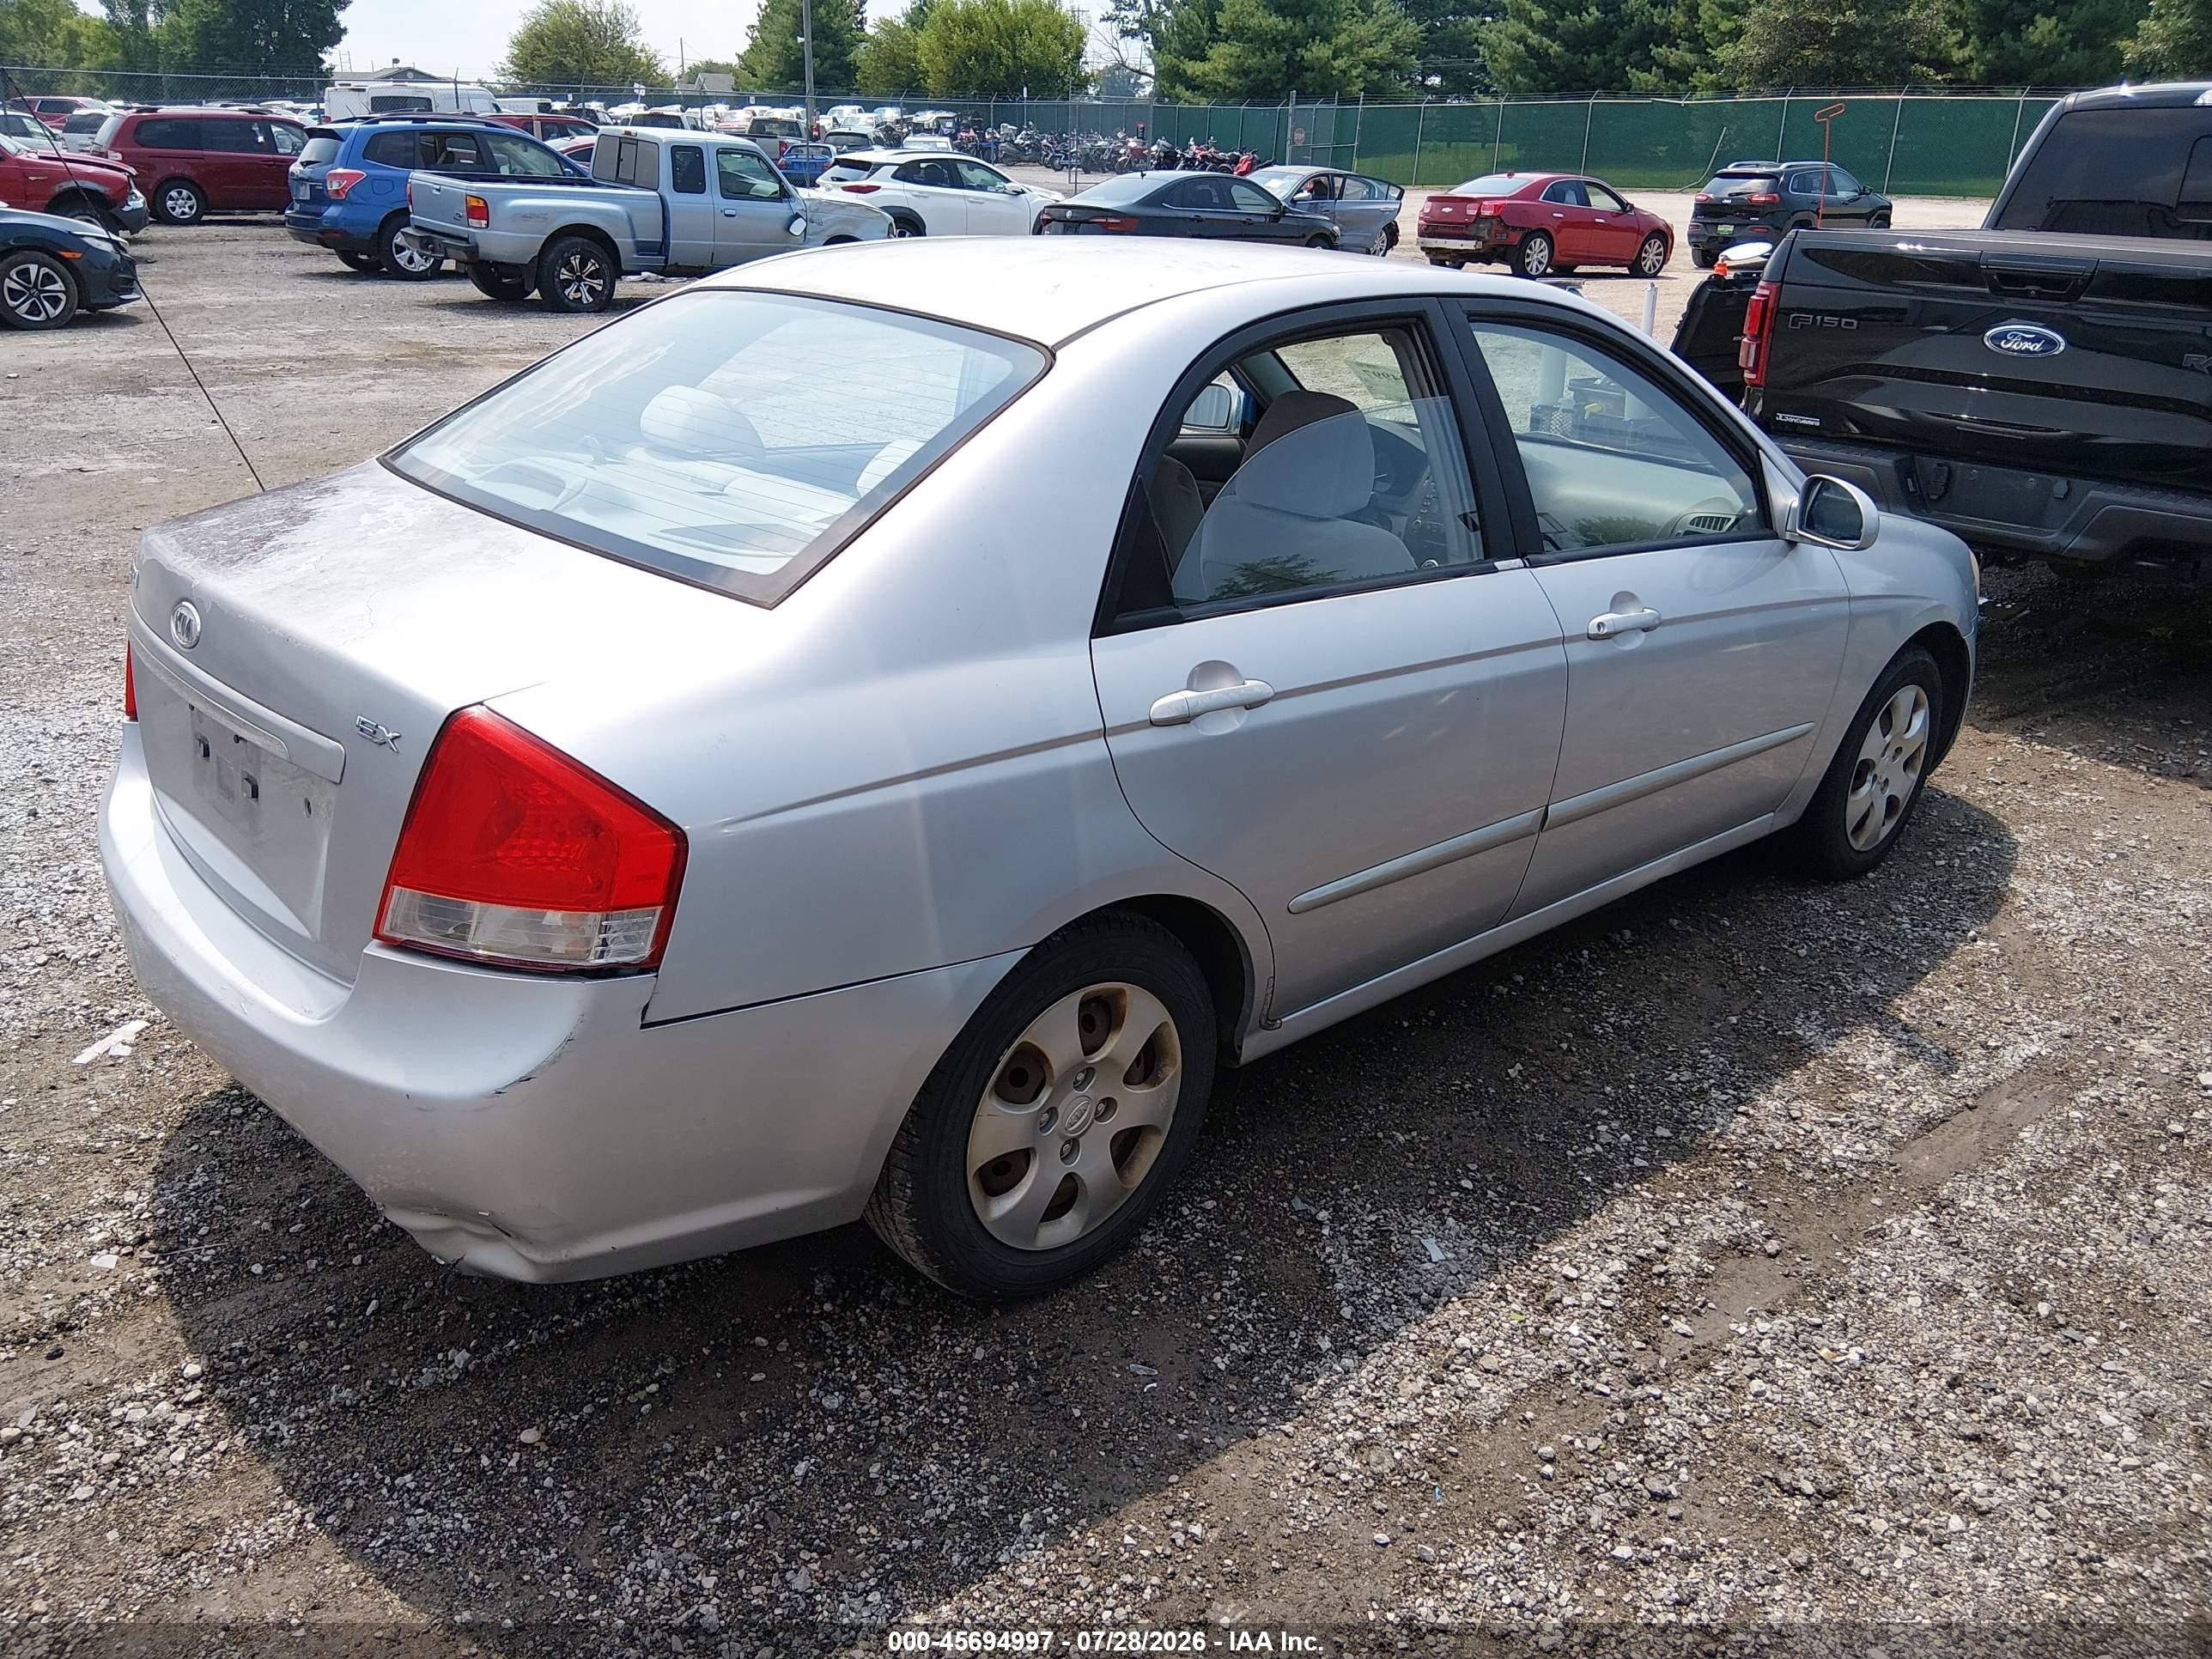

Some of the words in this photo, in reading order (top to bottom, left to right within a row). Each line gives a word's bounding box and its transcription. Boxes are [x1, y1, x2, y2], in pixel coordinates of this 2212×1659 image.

[2000, 331, 2045, 352] Ford
[174, 609, 193, 641] KIA
[356, 714, 402, 754] EX
